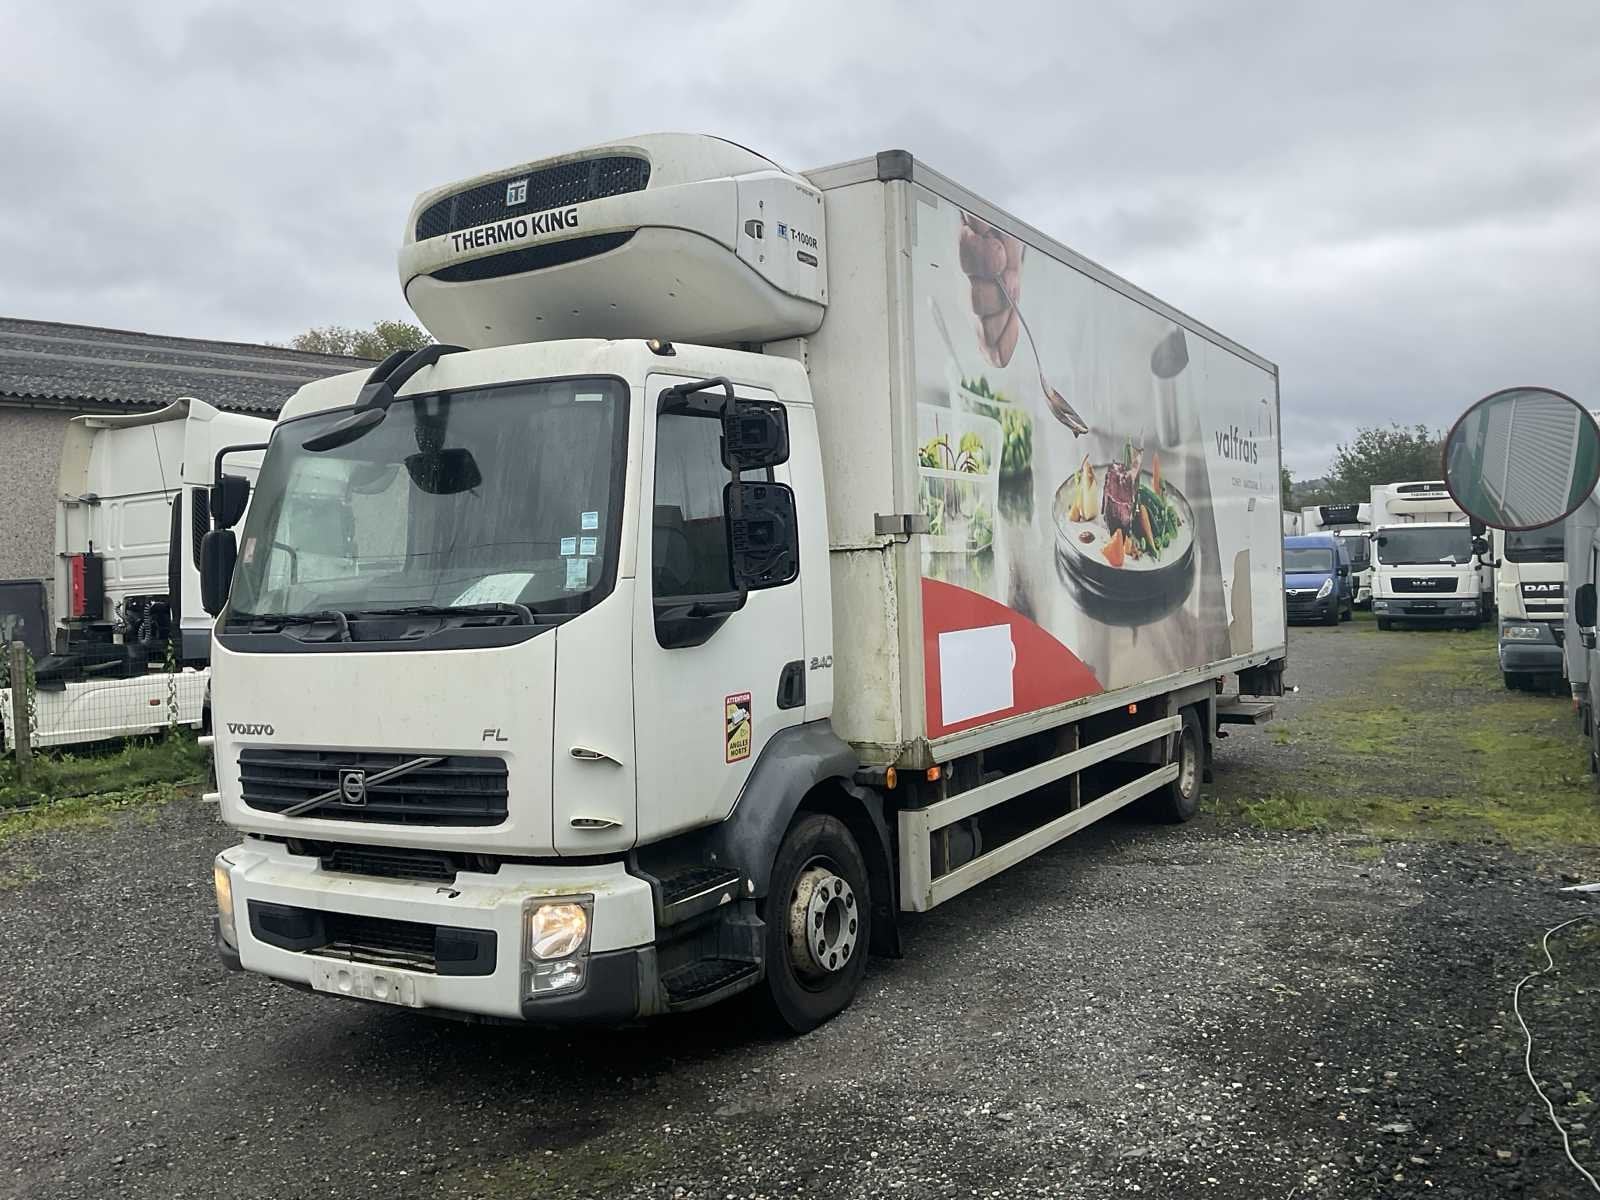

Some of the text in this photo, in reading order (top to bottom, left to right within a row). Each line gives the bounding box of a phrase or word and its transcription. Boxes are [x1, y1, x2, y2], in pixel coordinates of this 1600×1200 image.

[452, 207, 578, 252] THERMO KING
[790, 228, 818, 249] T-1000R
[1215, 425, 1258, 465] valfrais
[1524, 584, 1561, 592] DAF
[226, 723, 275, 736] VOLVO
[482, 728, 509, 742] FL
[729, 739, 748, 750] ANGLES
